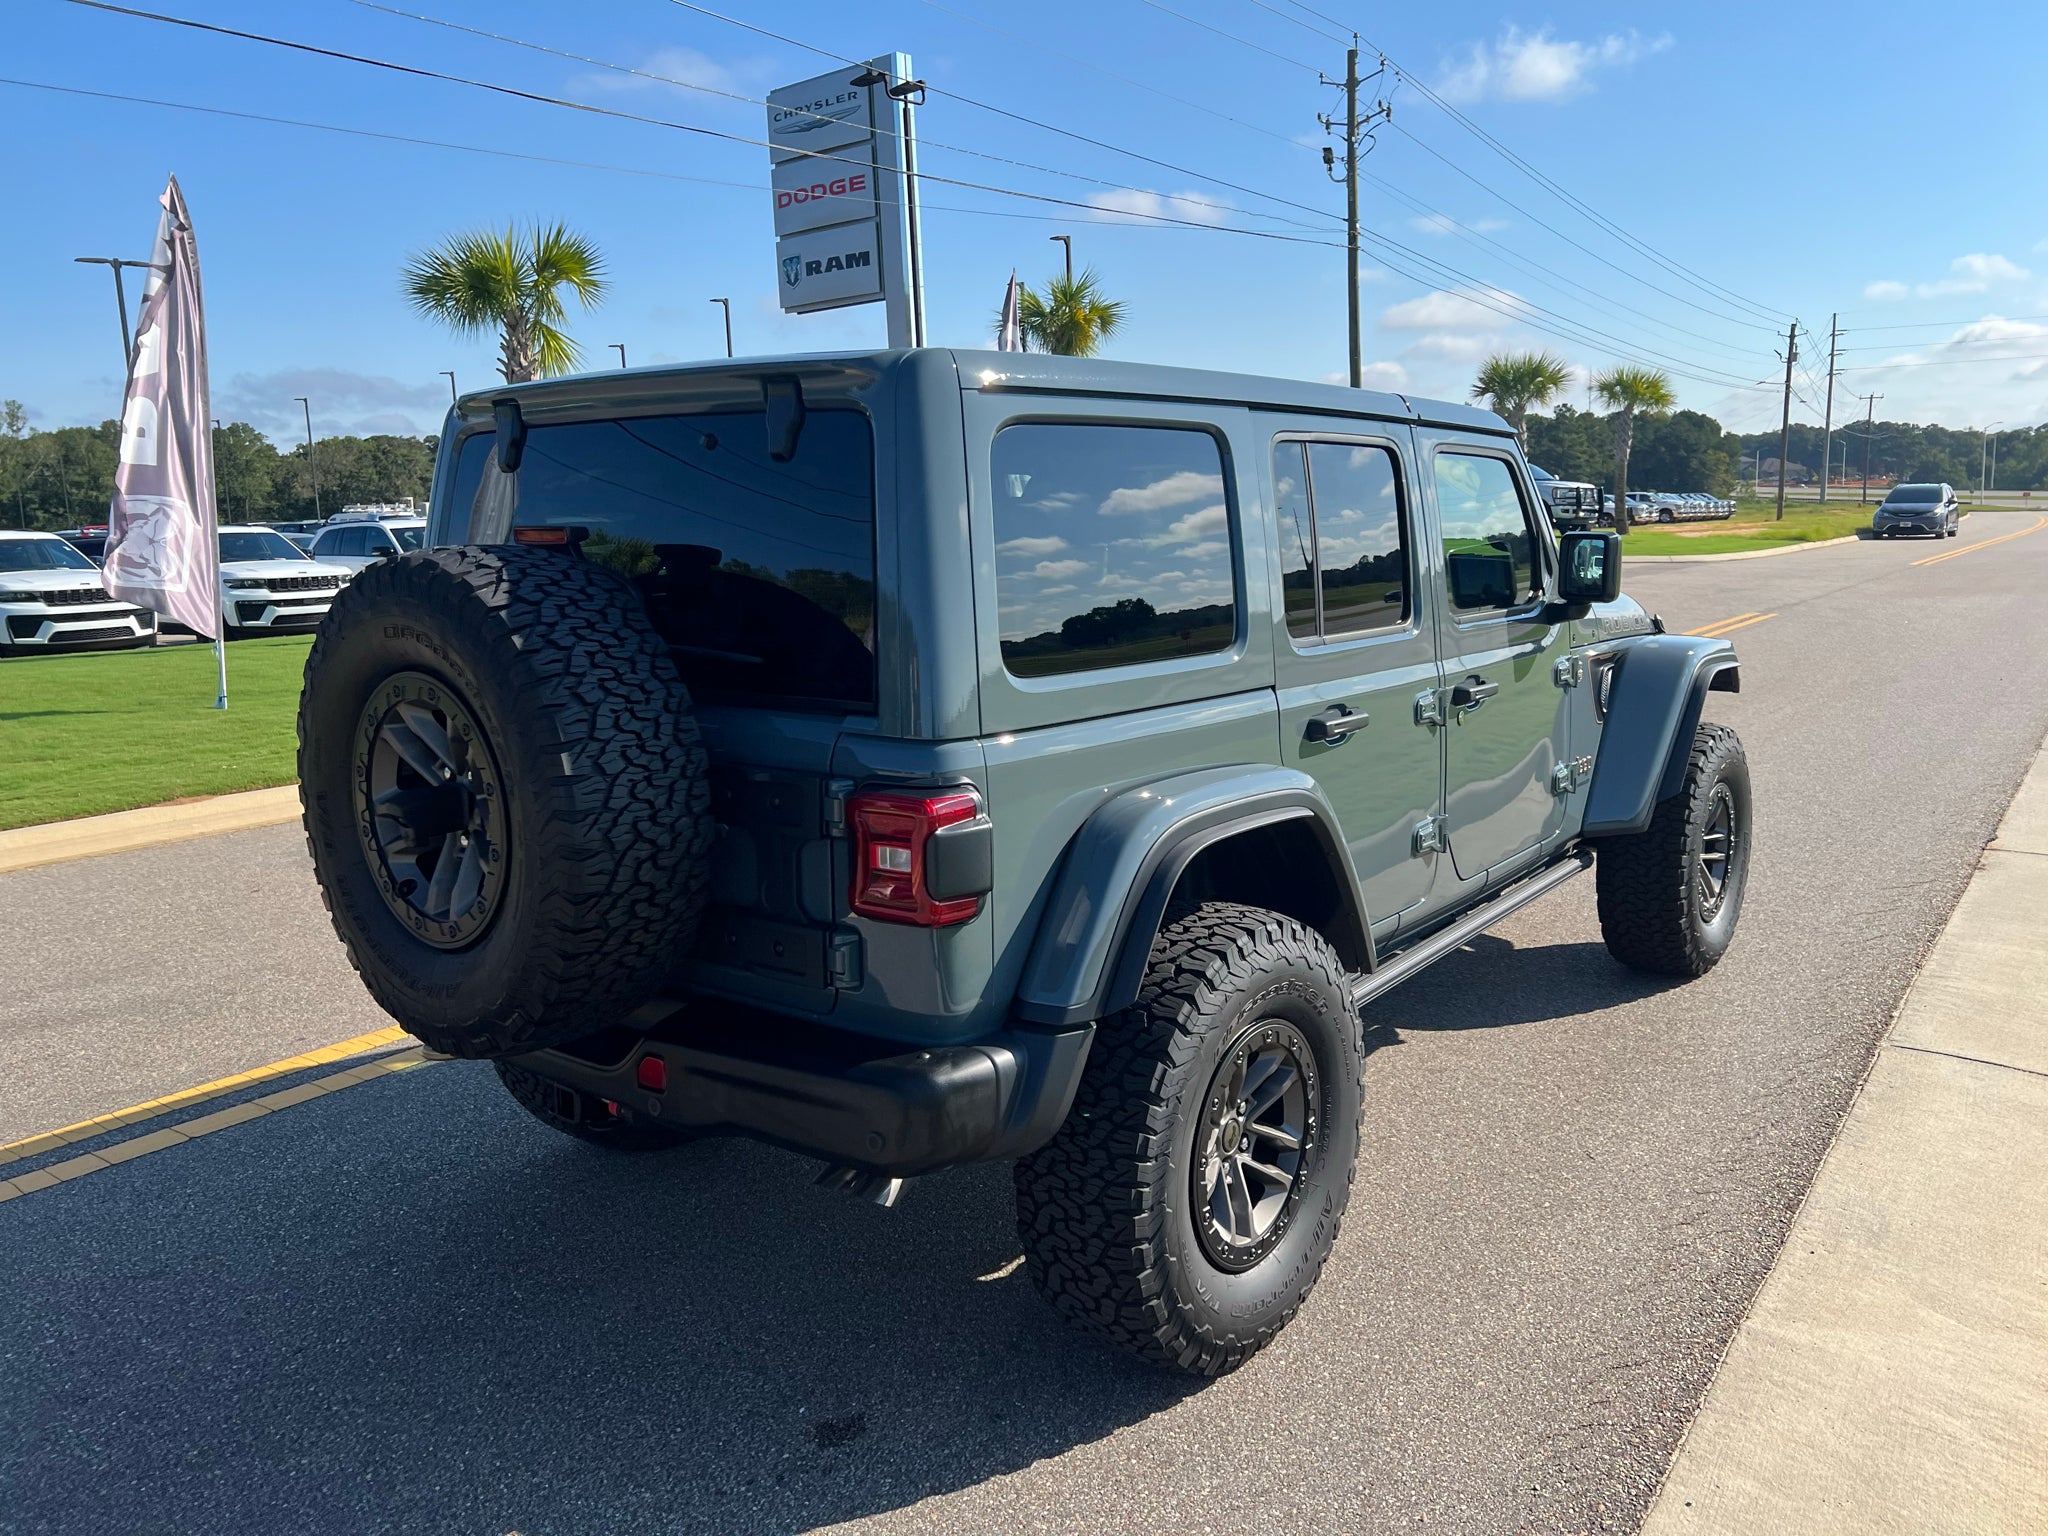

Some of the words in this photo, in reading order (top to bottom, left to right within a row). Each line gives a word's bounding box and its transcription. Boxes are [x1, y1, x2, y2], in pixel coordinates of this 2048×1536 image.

[773, 91, 858, 123] CHRYSLER
[777, 173, 867, 209] DODGE
[805, 250, 871, 276] RAM
